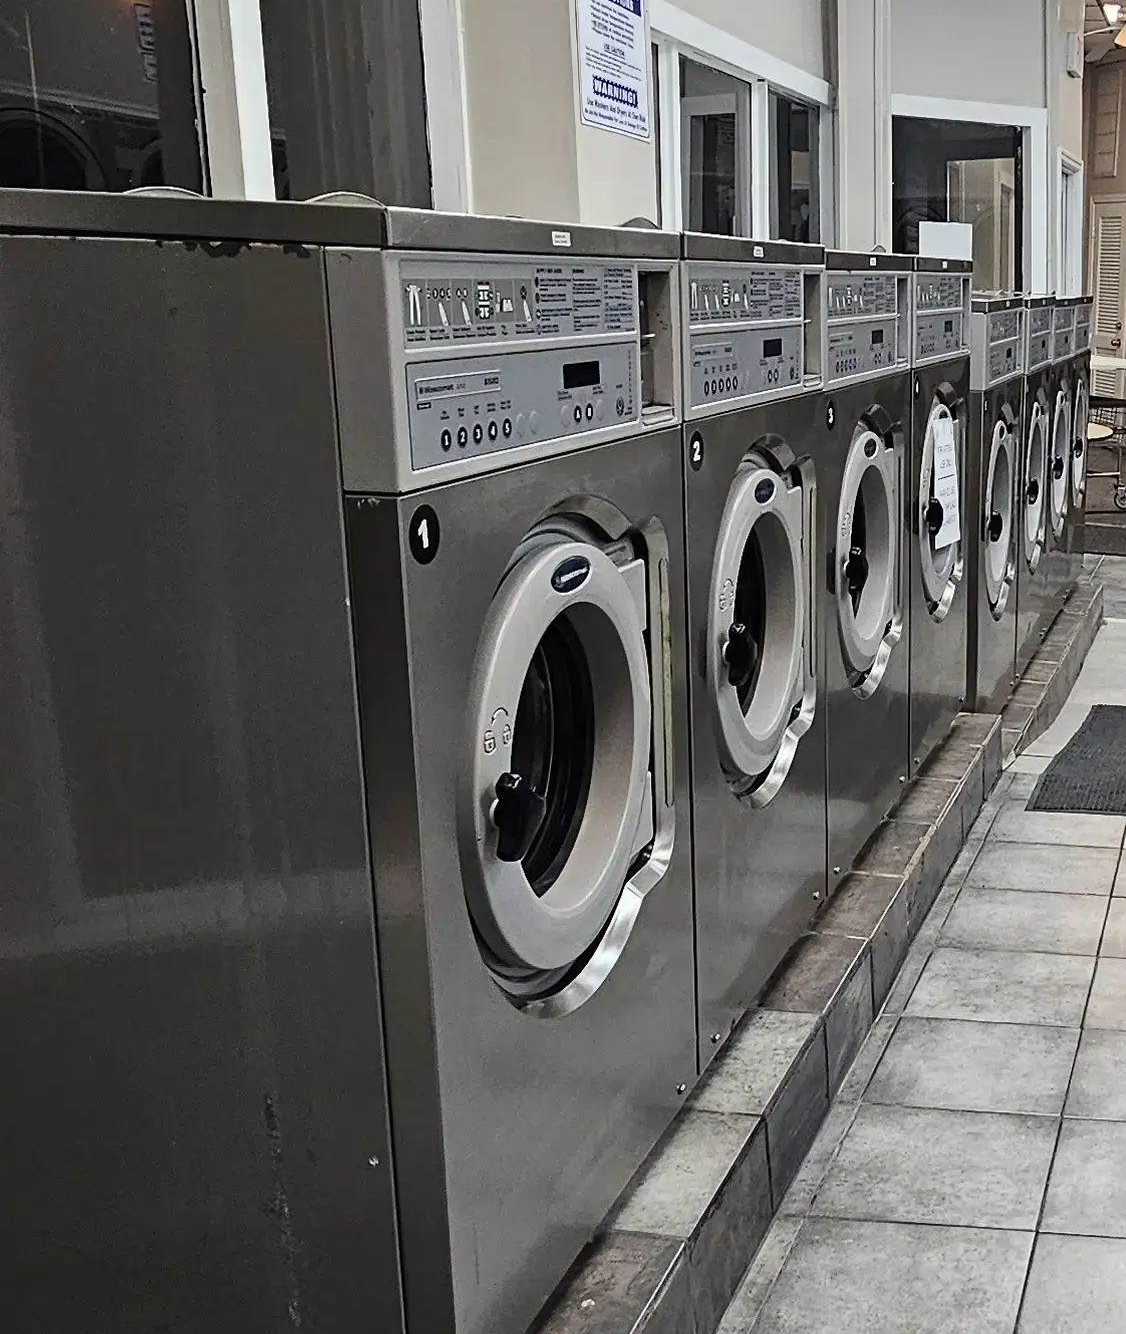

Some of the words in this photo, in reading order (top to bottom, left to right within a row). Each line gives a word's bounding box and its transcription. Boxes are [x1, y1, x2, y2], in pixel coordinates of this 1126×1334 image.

[594, 78, 636, 105] WARNING!
[828, 407, 834, 424] 3
[460, 431, 465, 442] 2
[476, 428, 481, 439] 3
[506, 423, 510, 433] 5
[693, 440, 701, 462] 2
[418, 518, 429, 549] 1
